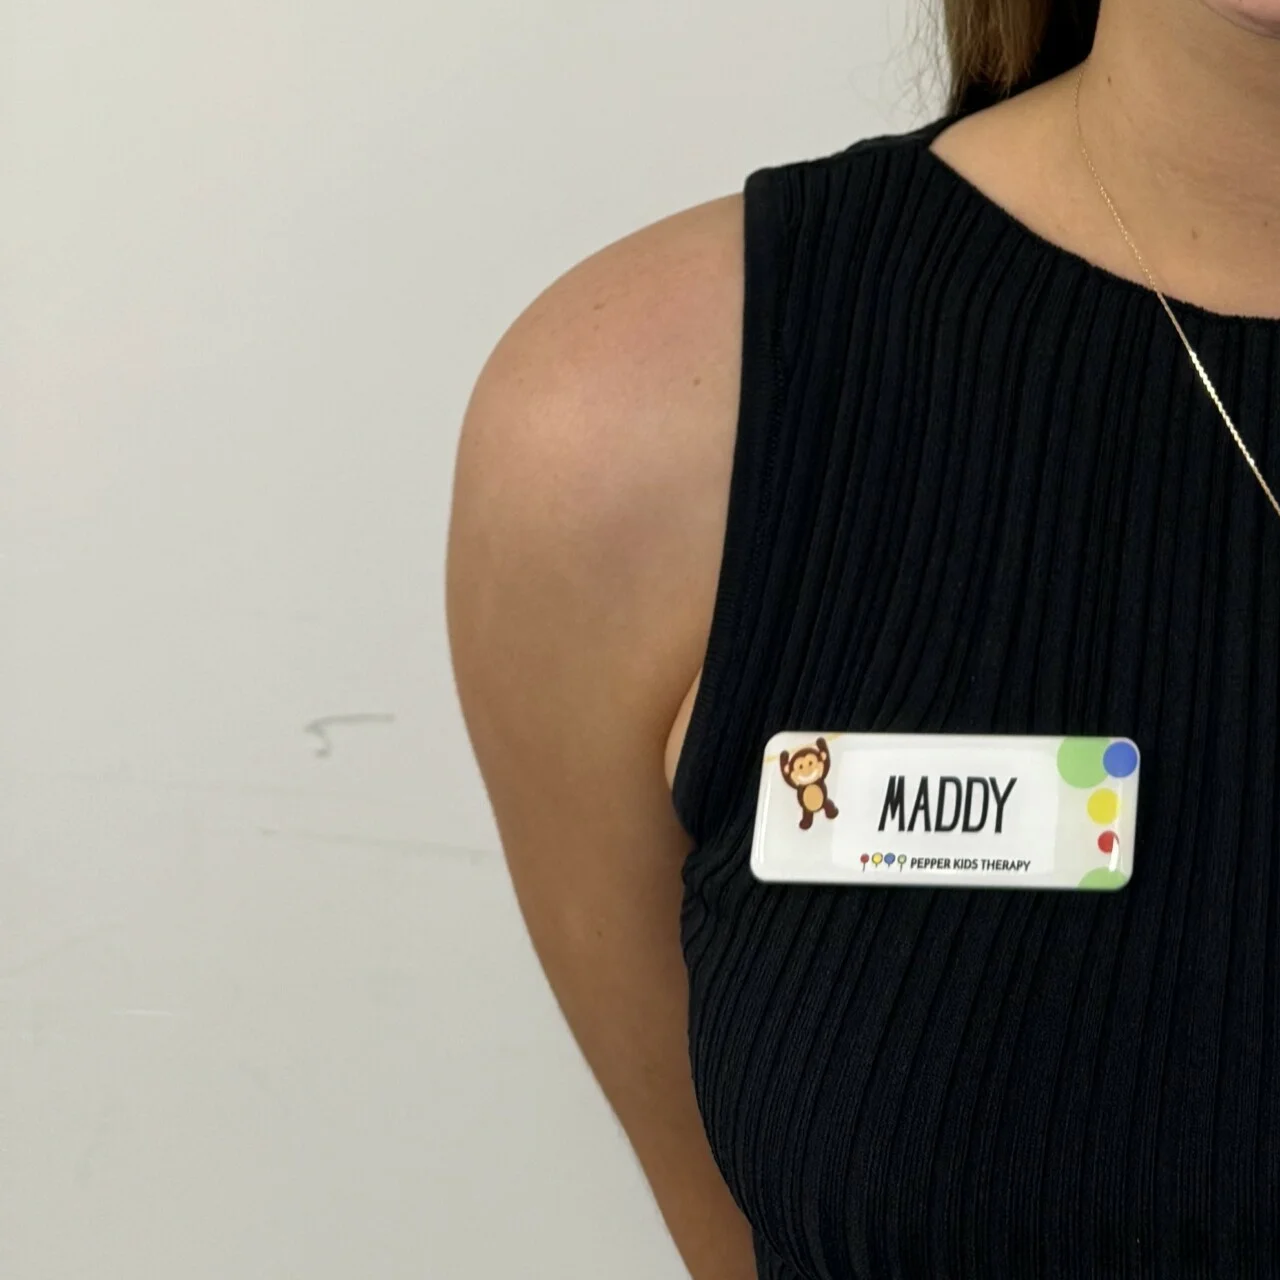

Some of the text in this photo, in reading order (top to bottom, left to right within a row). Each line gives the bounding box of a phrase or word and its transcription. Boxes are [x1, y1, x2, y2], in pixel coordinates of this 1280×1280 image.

[878, 775, 1018, 834] MADDY
[910, 857, 1031, 872] PEPPER KIDS THERAPY
